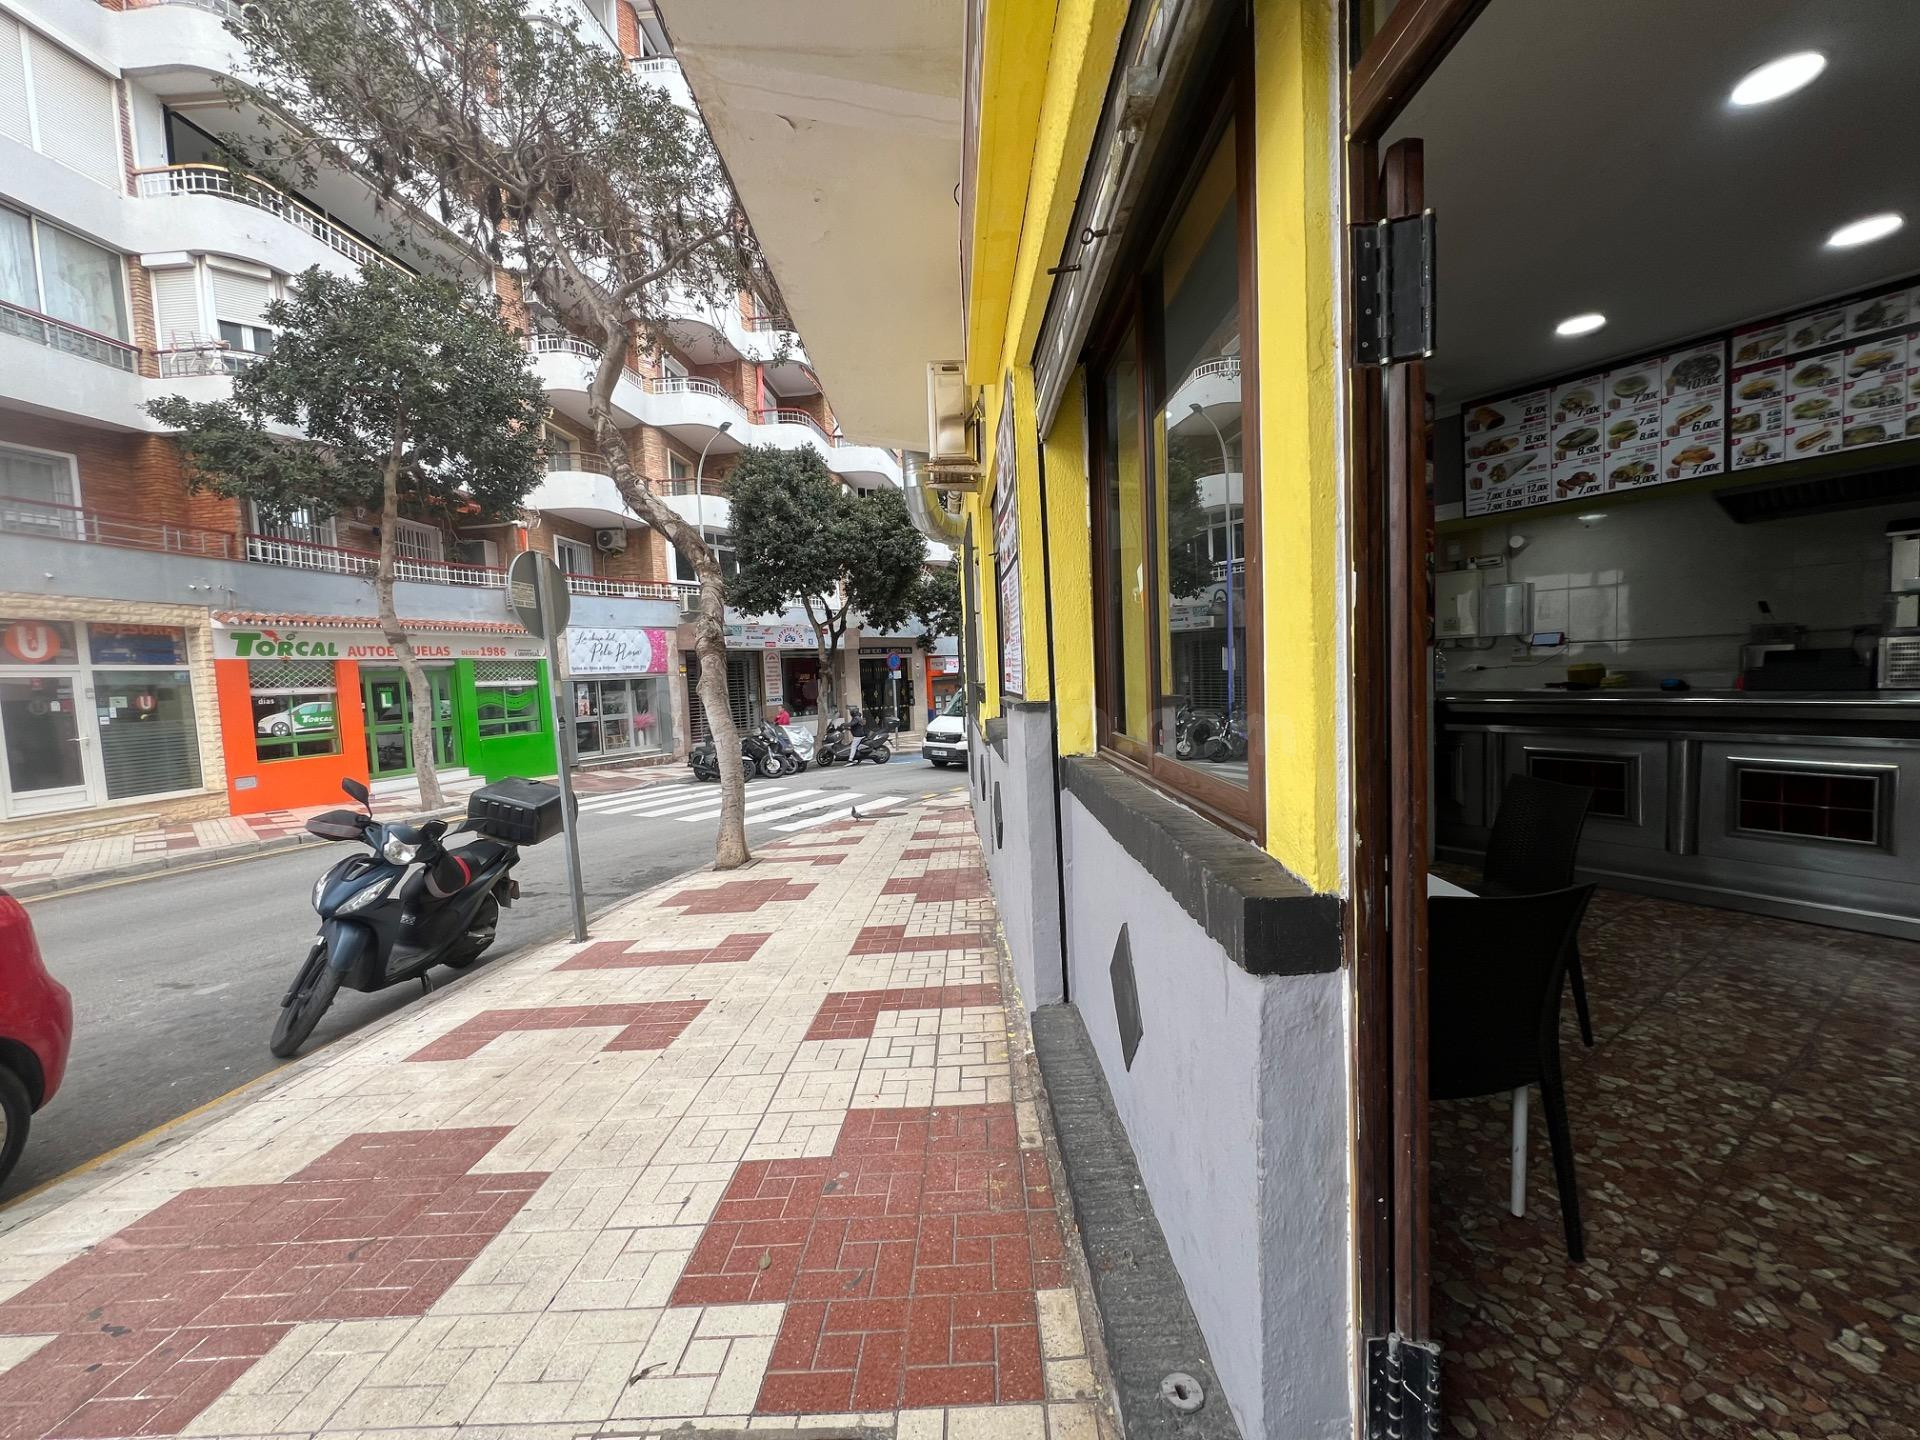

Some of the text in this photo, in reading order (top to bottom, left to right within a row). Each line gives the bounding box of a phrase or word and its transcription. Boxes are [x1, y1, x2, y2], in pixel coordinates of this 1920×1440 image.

[230, 632, 339, 657] TORCAL
[347, 645, 450, 658] AUTOEUELAS
[480, 646, 507, 657] 1986
